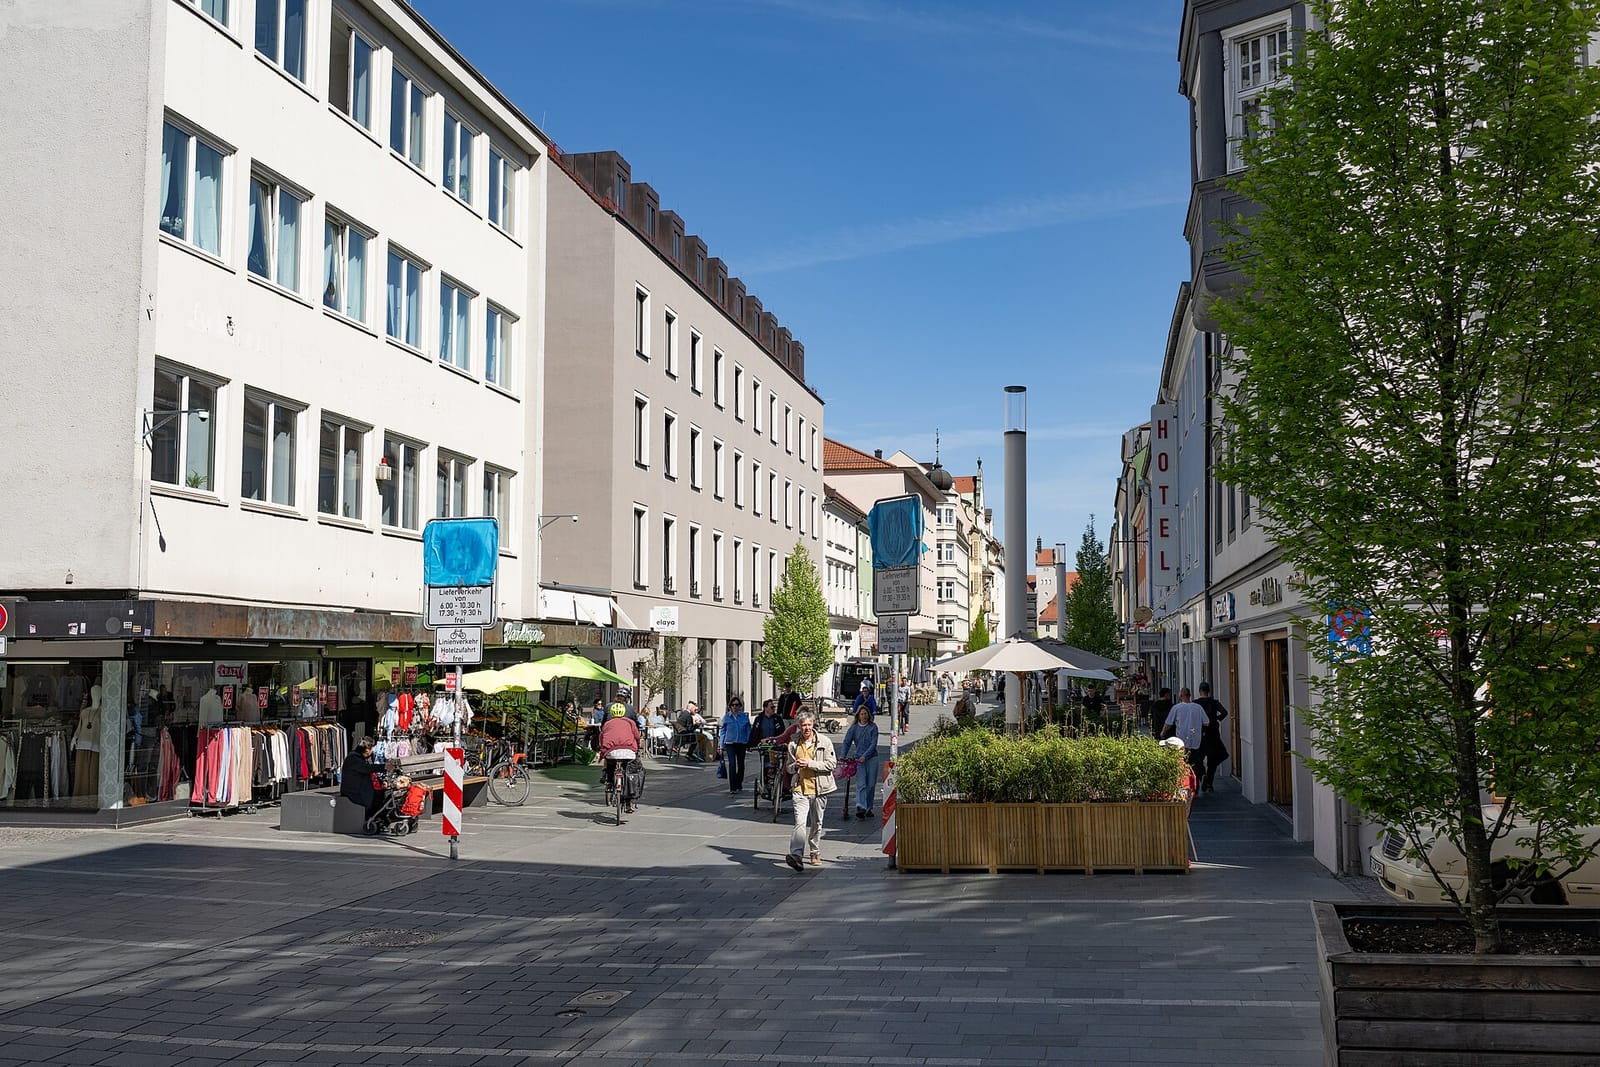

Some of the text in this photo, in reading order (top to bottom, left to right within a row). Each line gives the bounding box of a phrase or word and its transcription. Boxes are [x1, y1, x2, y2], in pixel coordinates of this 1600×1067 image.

[1157, 419, 1170, 571] HOTEL
[656, 619, 675, 627] elaya
[601, 629, 651, 648] URBAN COFFEE
[220, 667, 241, 676] CRAZY
